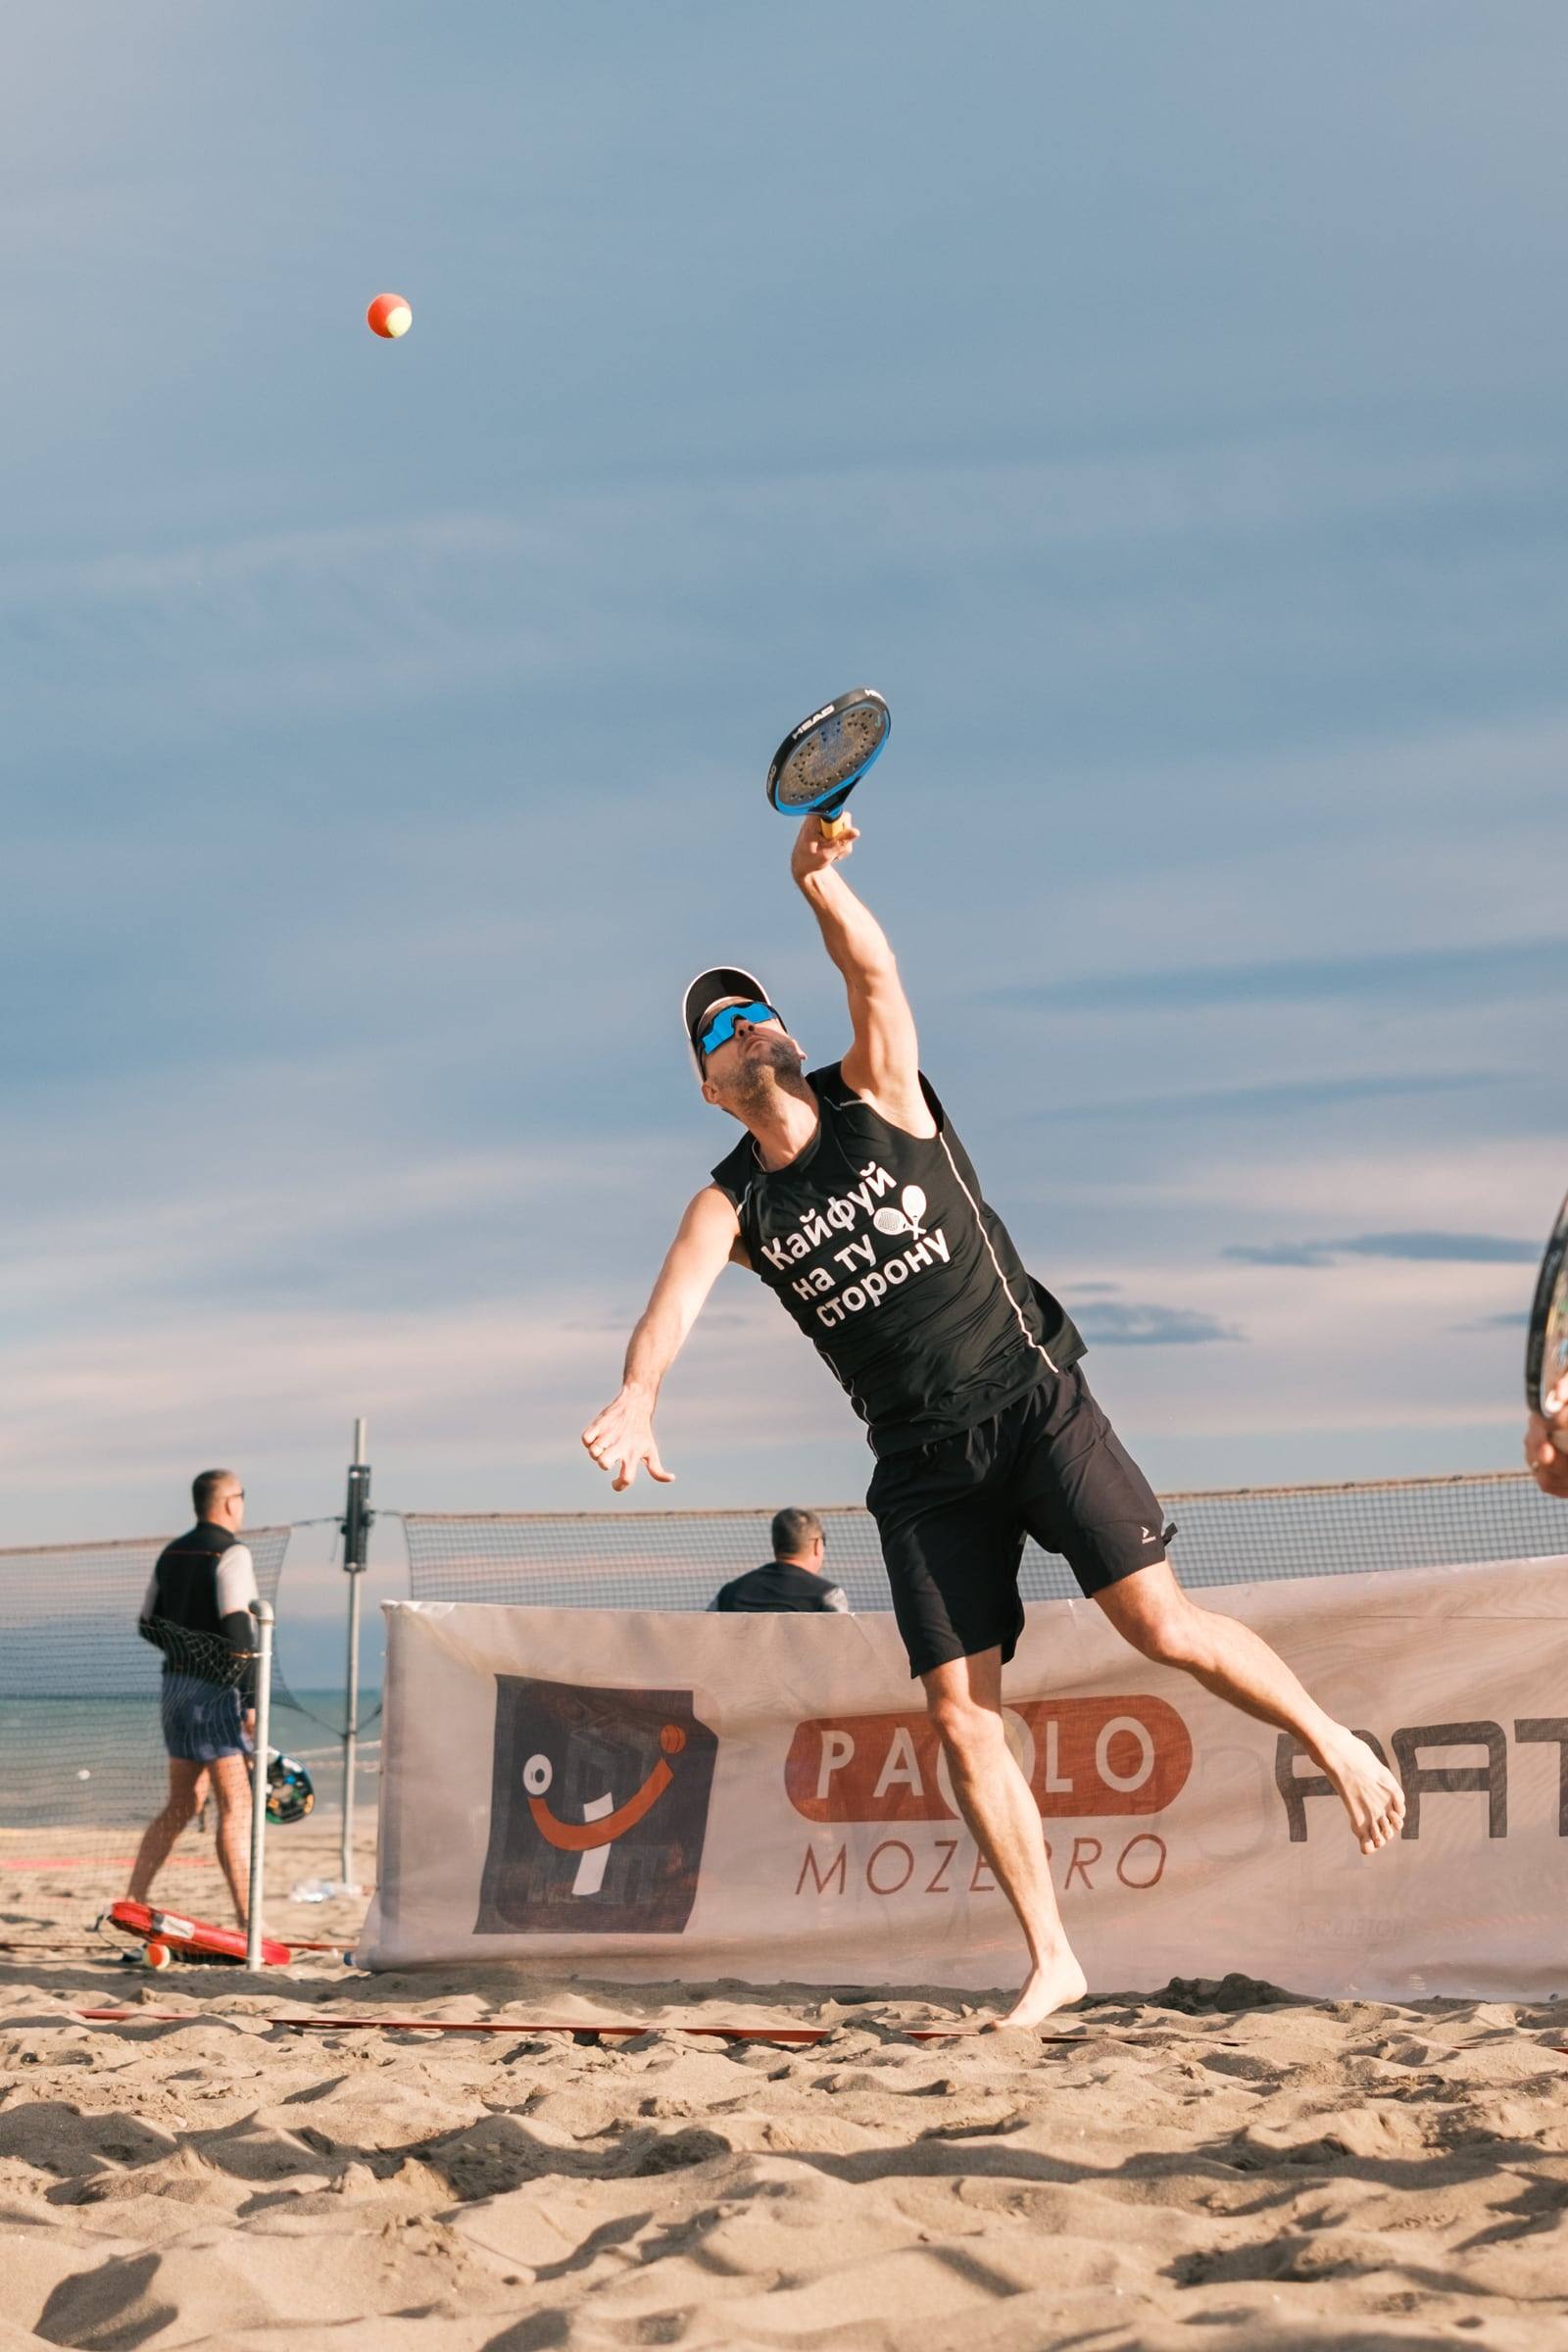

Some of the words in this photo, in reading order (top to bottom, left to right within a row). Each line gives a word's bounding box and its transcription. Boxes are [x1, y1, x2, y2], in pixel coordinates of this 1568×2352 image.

[760, 1160, 897, 1270] Кайфуй
[792, 1266, 836, 1300] на
[833, 1234, 877, 1272] ту
[815, 1228, 951, 1327] сторону
[795, 1833, 1167, 1895] MOZERO
